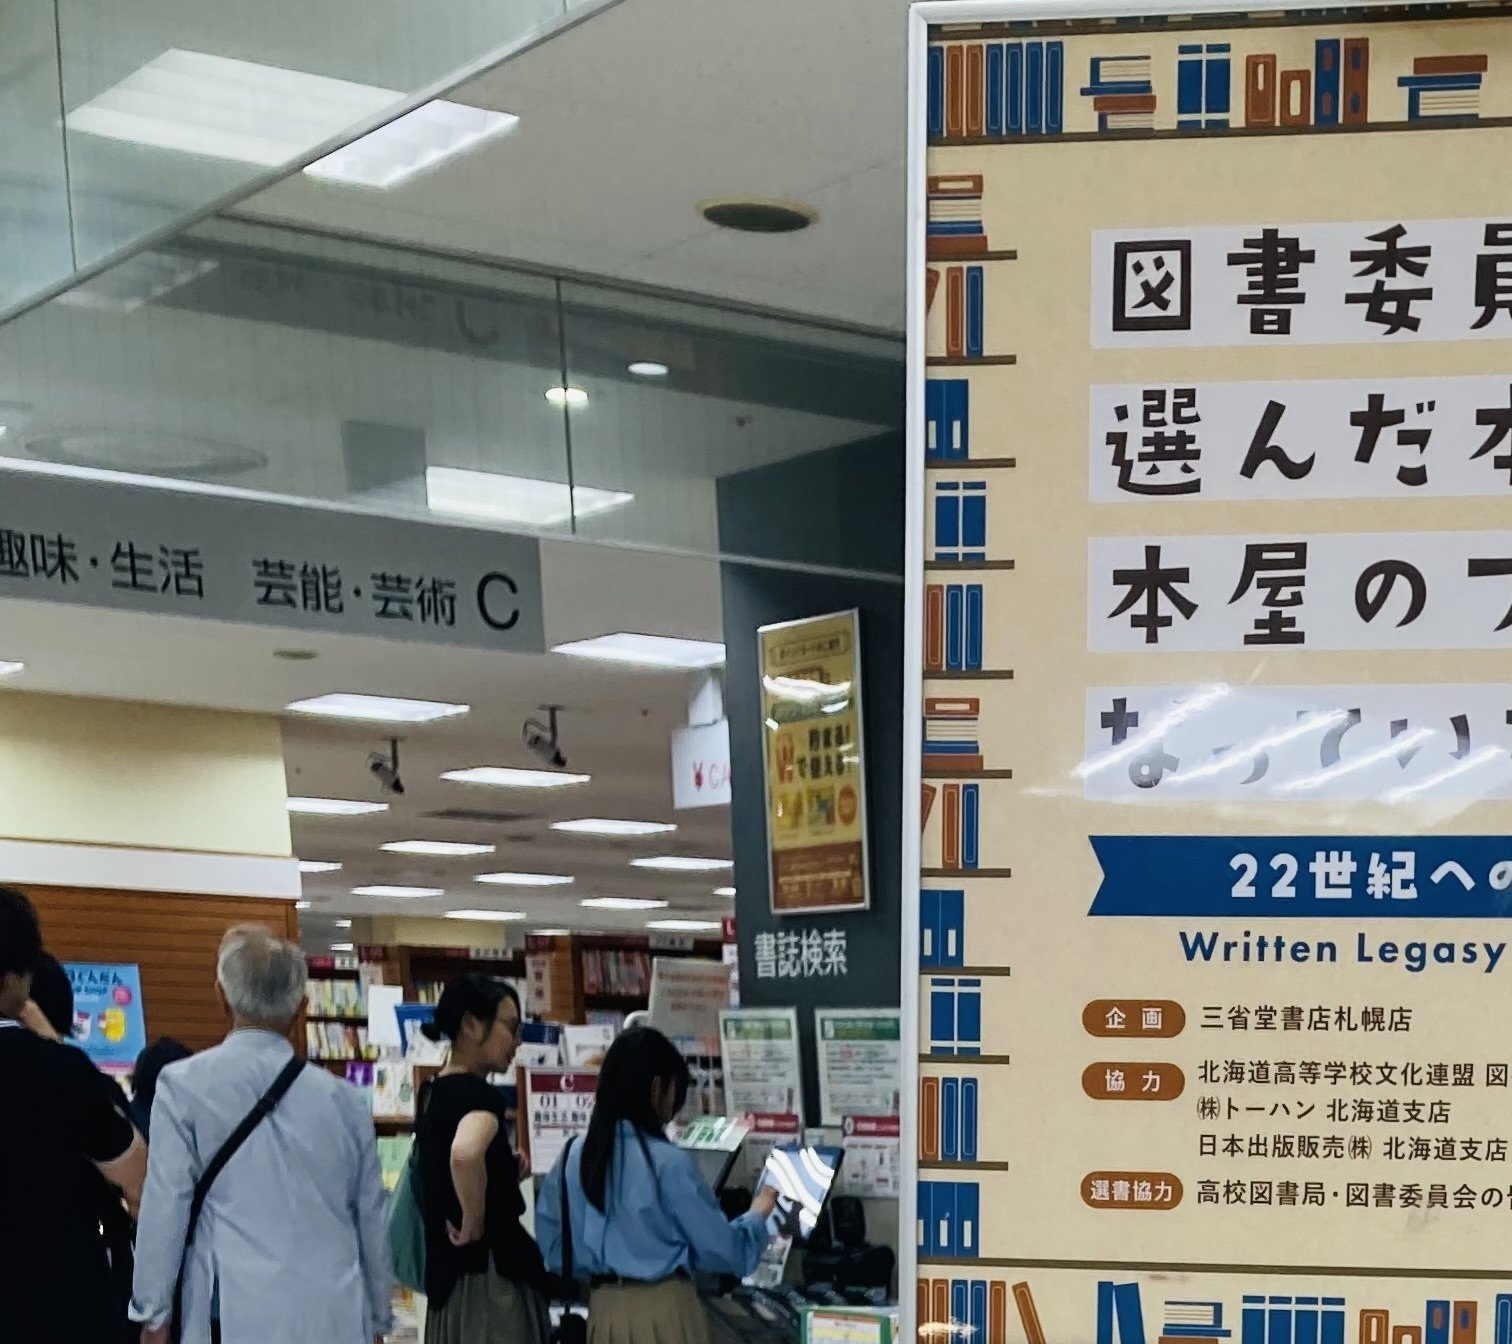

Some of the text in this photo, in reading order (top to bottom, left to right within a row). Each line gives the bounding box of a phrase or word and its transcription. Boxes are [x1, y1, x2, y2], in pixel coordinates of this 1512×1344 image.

[253, 557, 520, 631] 芸能・芸術 C
[754, 928, 848, 978] 書誌検索
[1179, 931, 1338, 964] Written
[1356, 931, 1507, 974] Legasy
[1105, 1005, 1413, 1034] 企画 三省堂書店札幌店
[1105, 1068, 1162, 1095] 協力
[1197, 1059, 1475, 1090] 北海道高等学校文化連盟
[1326, 1096, 1451, 1125] 北海道支店
[1382, 1135, 1509, 1163] 北海道支店
[1090, 1178, 1174, 1203] 選書協力
